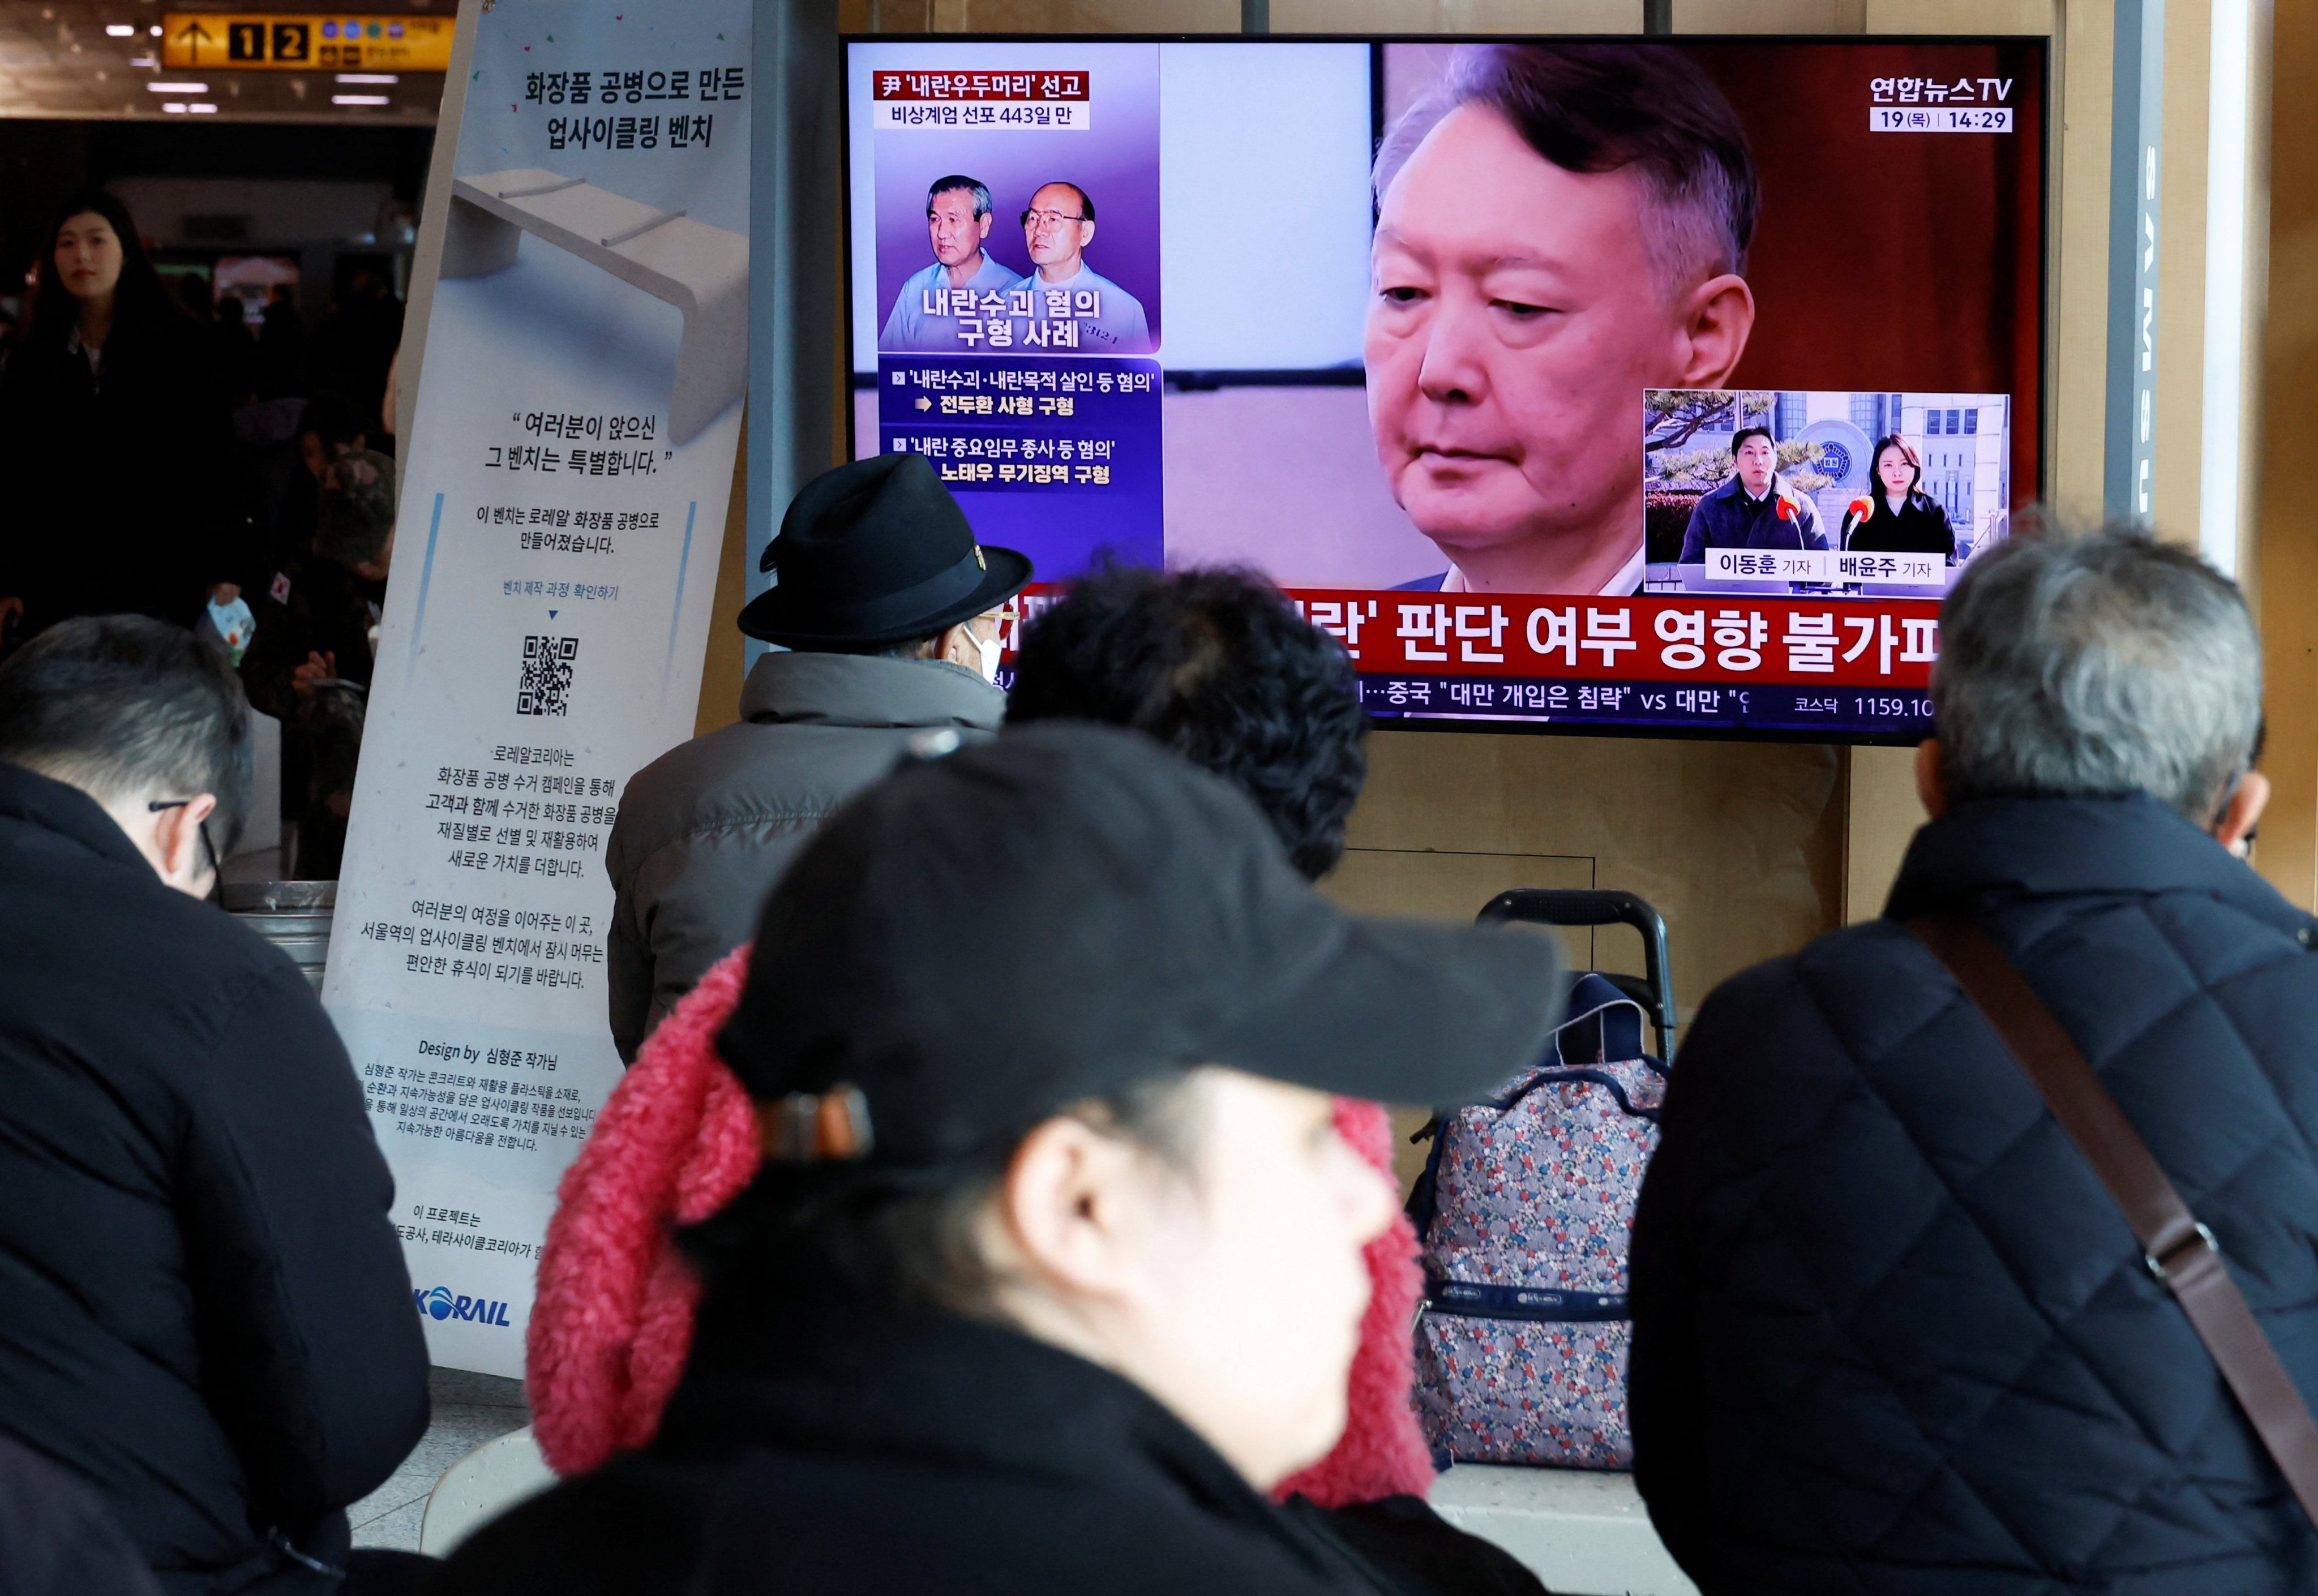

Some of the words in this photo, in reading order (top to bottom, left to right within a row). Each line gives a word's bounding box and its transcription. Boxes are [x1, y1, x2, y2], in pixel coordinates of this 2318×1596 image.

[525, 71, 592, 105] 화장품
[599, 70, 689, 104] 공병으로
[699, 67, 745, 101] 만든
[882, 76, 902, 97] 尹
[906, 74, 1036, 98] '내란우두머리'
[1040, 75, 1081, 98] 선고
[1870, 77, 2013, 102] 연합뉴스TV
[892, 106, 957, 125] 비상계엄
[962, 106, 996, 125] 선포
[999, 106, 1050, 125] 443일
[1055, 106, 1072, 125] 만
[1949, 111, 2006, 128] 14:29
[547, 115, 659, 150] 업사이클링
[669, 114, 713, 148] 벤치
[923, 288, 1034, 318] 내란수괴
[1045, 290, 1100, 319] 혐의
[958, 318, 1013, 346] 구형
[1022, 319, 1078, 347] 사례
[1060, 371, 1093, 392] 살인
[1096, 372, 1114, 393] 등
[1116, 372, 1155, 393] 혐의'
[940, 395, 993, 414] 전두환
[997, 396, 1033, 415] 사형
[1038, 396, 1074, 416] 구형
[609, 414, 655, 440] 앉으신
[485, 447, 502, 467] 그
[508, 445, 560, 472] 벤치는
[911, 436, 949, 457] '내란
[950, 437, 1018, 458] 중요임무
[1020, 439, 1056, 460] 종사
[1057, 440, 1075, 460] 등
[1077, 440, 1115, 460] 혐의'
[941, 463, 993, 482] 노태우
[999, 464, 1069, 483] 무기징역
[1074, 465, 1110, 484] 구형
[477, 506, 489, 524] 이
[494, 507, 526, 525] 벤치는
[528, 508, 571, 527] 로레알
[573, 511, 614, 530] 화장품
[617, 512, 659, 530] 공병으로
[521, 531, 614, 555] 만들어졌습니다.
[1720, 554, 1777, 574] 이동훈
[1783, 560, 1811, 575] 기자
[1840, 557, 1897, 578] 배윤주
[1903, 563, 1932, 578] 기자
[503, 580, 521, 595] 벤치
[524, 581, 543, 596] 제작
[546, 582, 570, 598] 과정
[573, 584, 619, 601] 확인하기
[1396, 603, 1509, 663] 판단
[1527, 607, 1637, 667] 여부
[1653, 609, 1768, 671] 영향
[1439, 681, 1494, 706] "대만
[1502, 685, 1569, 709] 개입은
[1578, 686, 1631, 710] 침략"
[1640, 694, 1666, 710] vs
[1676, 689, 1720, 713] 대만
[1794, 697, 1838, 714] 코스닥
[493, 745, 575, 767] 로레알코리아는
[437, 766, 479, 787] 화장품
[483, 771, 510, 790] 공병
[513, 774, 538, 792] 수거
[542, 775, 585, 795] 캠페인을
[589, 778, 615, 797] 통해
[425, 793, 469, 814] 고객과
[473, 797, 499, 817] 함께
[502, 800, 540, 820] 수거한
[543, 803, 577, 823] 화장품
[580, 805, 616, 825] 공병을
[437, 821, 491, 842] 재질별로
[496, 827, 521, 846] 선별
[526, 829, 538, 847] 및
[541, 831, 598, 852] 재활용하여
[448, 850, 489, 870] 새로운
[492, 854, 531, 874] 가치를
[534, 857, 584, 878] 더합니다.
[412, 900, 467, 923] 여러분의
[472, 907, 511, 928] 여정을
[515, 911, 562, 932] 이어주는
[565, 915, 576, 933] 이
[579, 916, 593, 937] 곳,
[361, 921, 415, 945] 서울역의
[420, 928, 488, 953] 업사이클링
[492, 937, 542, 958] 벤치에서
[545, 941, 568, 960] 잠시
[571, 943, 603, 963] 머무는
[406, 954, 447, 975] 편안한
[451, 959, 491, 981] 휴식이
[494, 964, 533, 985] 되기를
[536, 968, 584, 989] 바랍니다.
[418, 1040, 460, 1061] Design
[463, 1044, 481, 1065] by
[487, 1048, 522, 1067] 심형준
[525, 1052, 558, 1071] 작가님
[365, 1063, 395, 1079] 심형준
[397, 1067, 426, 1083] 작가는
[428, 1071, 476, 1089] 콘크리트와
[478, 1079, 508, 1094] 재활용
[510, 1082, 553, 1100] 플라스틱을
[554, 1088, 581, 1104] 소재로,
[367, 1082, 397, 1097] 순환과
[400, 1086, 456, 1105] 지속가능성을
[459, 1093, 478, 1108] 담은
[481, 1096, 529, 1114] 업사이클링
[532, 1103, 556, 1118] 작품을
[376, 1100, 397, 1114] 통해
[400, 1103, 427, 1119] 일상의
[429, 1107, 468, 1125] 공간에서
[469, 1113, 510, 1130] 오래도록
[512, 1119, 540, 1134] 가치를
[542, 1122, 558, 1136] 지닐
[560, 1125, 568, 1137] 수
[570, 1126, 586, 1139] 있는
[396, 1121, 443, 1139] 지속가능한
[445, 1127, 494, 1146] 아름다움을
[497, 1135, 537, 1152] 전합니다.
[413, 1205, 424, 1220] 이
[426, 1207, 481, 1228] 프로젝트는
[393, 1224, 429, 1245] 도공사,
[431, 1230, 532, 1258] 테라사이클코리아가
[413, 1286, 510, 1327] KORAIL
